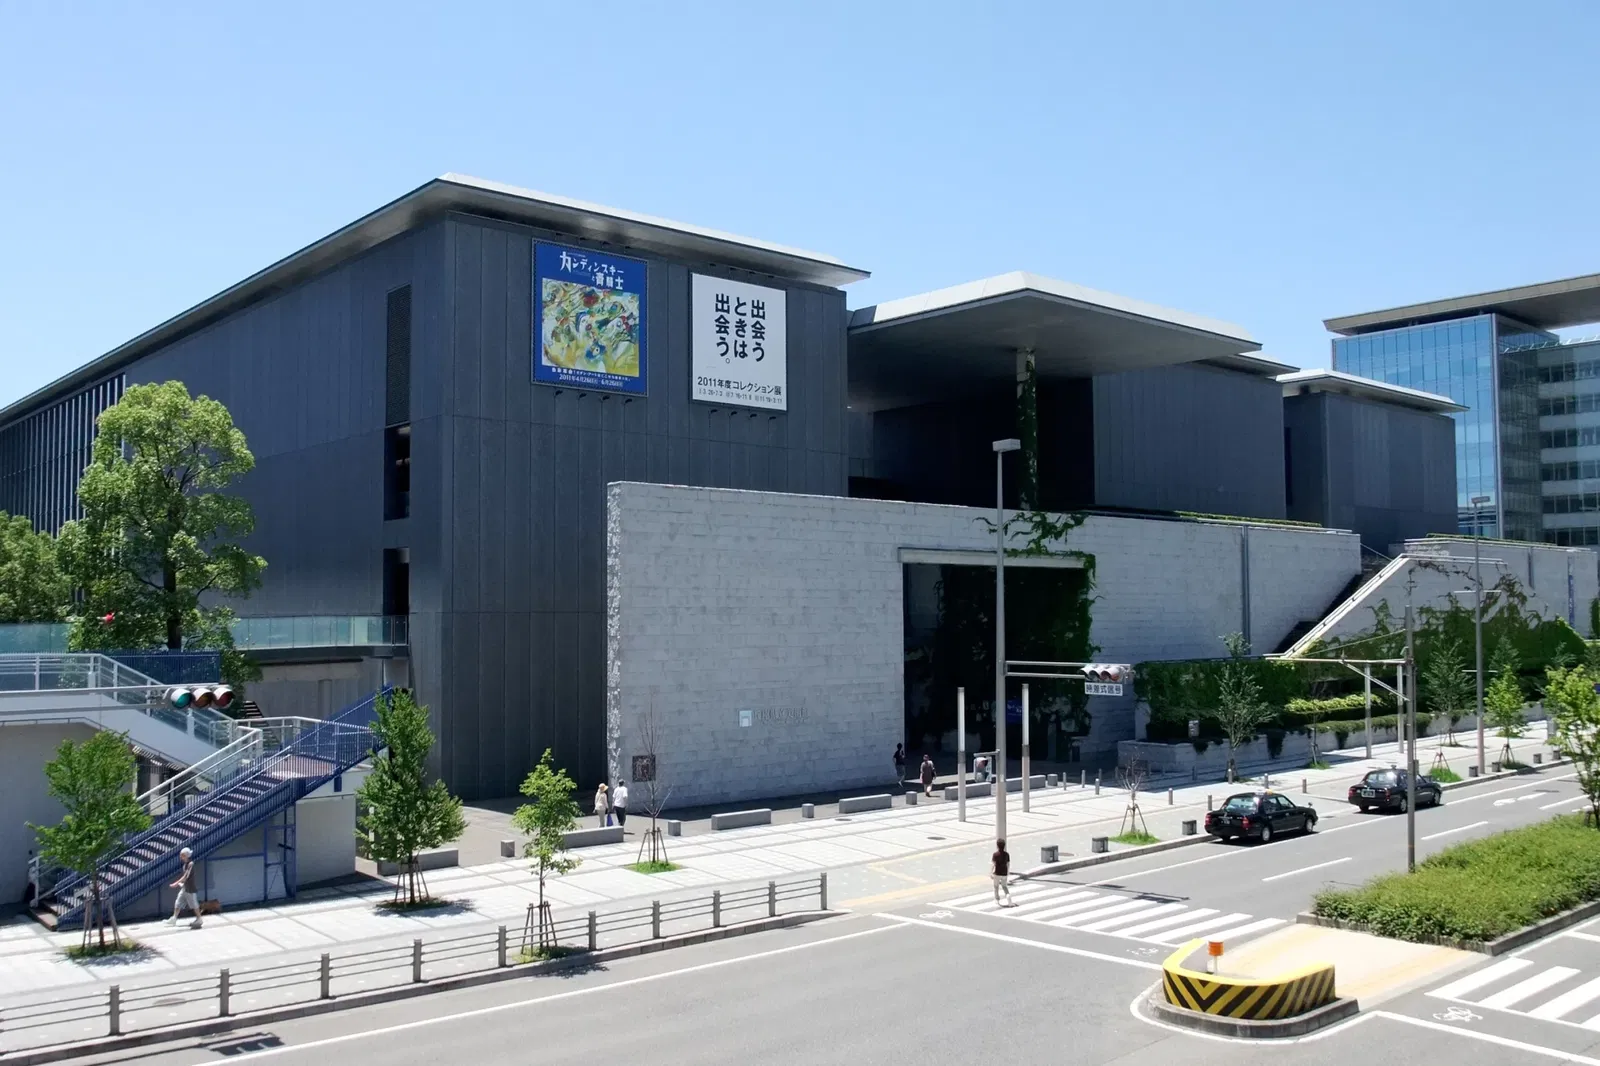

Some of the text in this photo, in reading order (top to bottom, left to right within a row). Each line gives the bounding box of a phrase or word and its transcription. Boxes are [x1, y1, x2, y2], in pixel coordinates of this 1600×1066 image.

[560, 251, 624, 275] カンディンスキー
[714, 293, 731, 364] 出会う。
[734, 296, 748, 359] ときは
[751, 299, 766, 362] 出会う
[697, 376, 782, 396] 2011年度コレクション展
